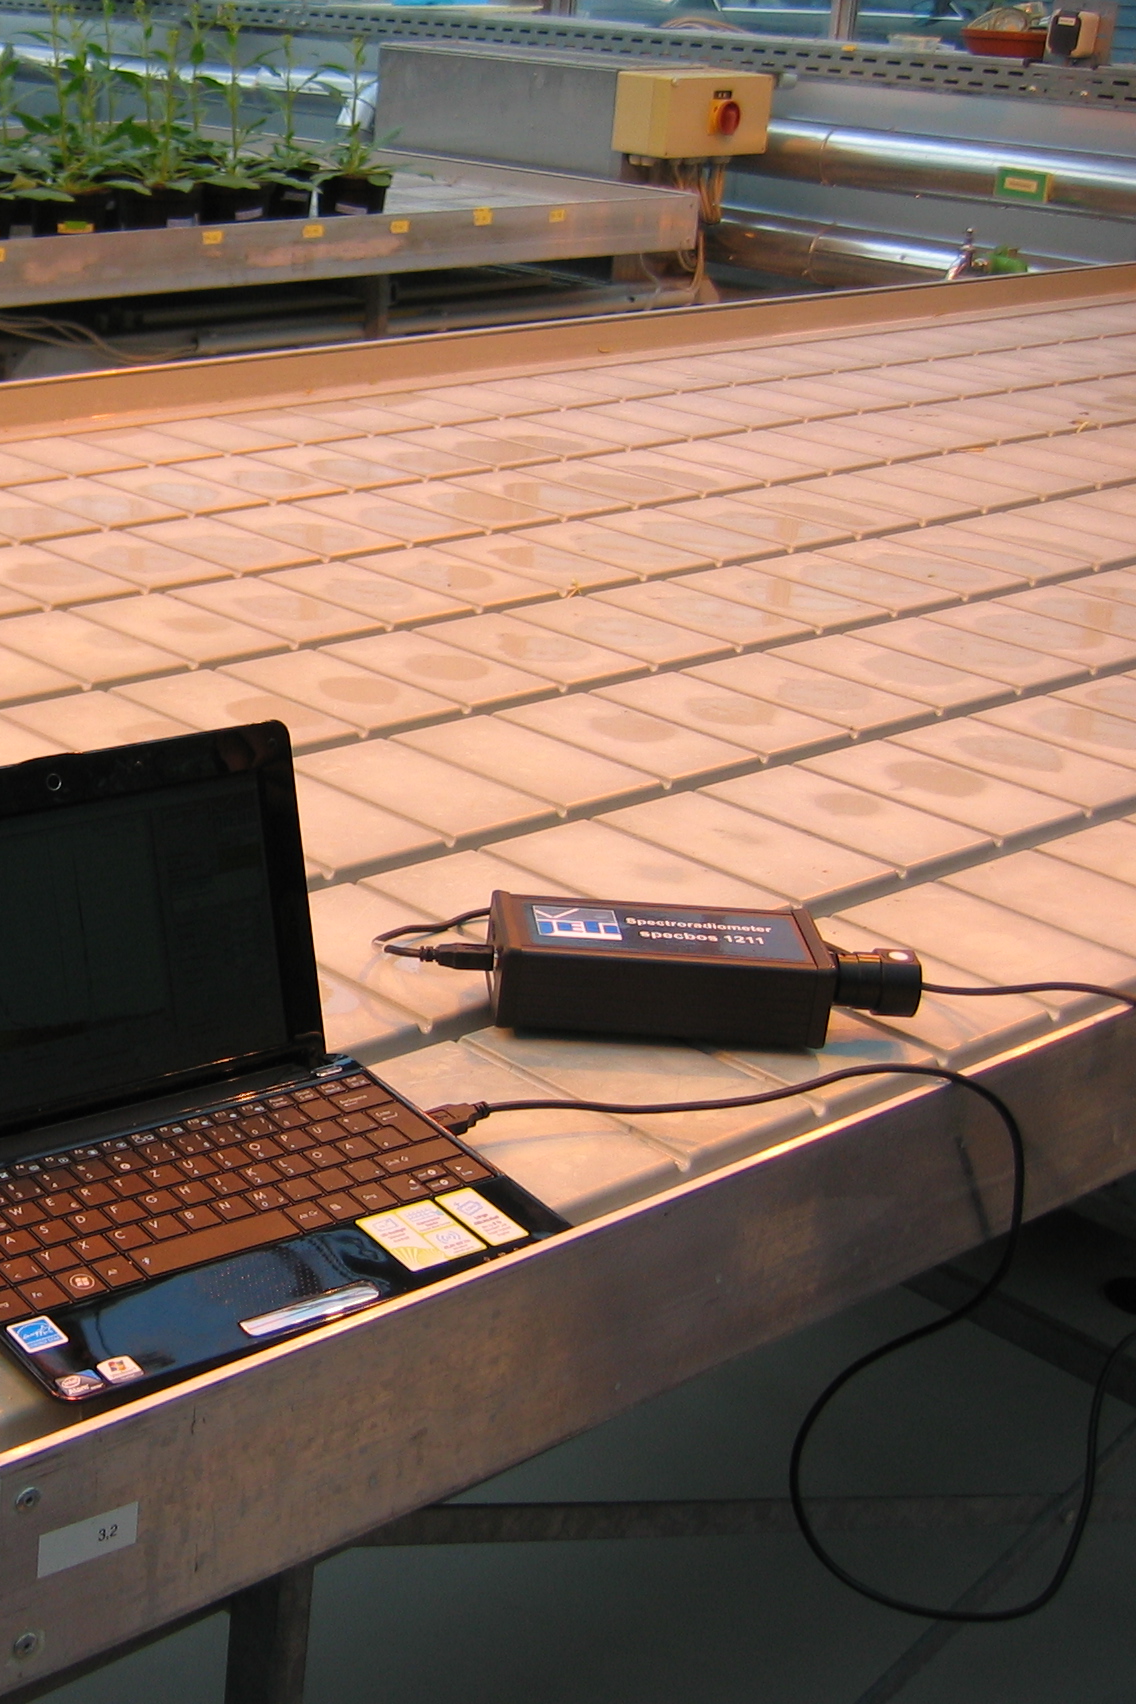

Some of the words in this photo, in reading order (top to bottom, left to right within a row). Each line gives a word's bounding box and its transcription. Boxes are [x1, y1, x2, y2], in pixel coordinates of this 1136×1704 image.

[625, 915, 773, 934] Spectroradiometer
[639, 929, 719, 943] specbos
[723, 933, 765, 946] 1211
